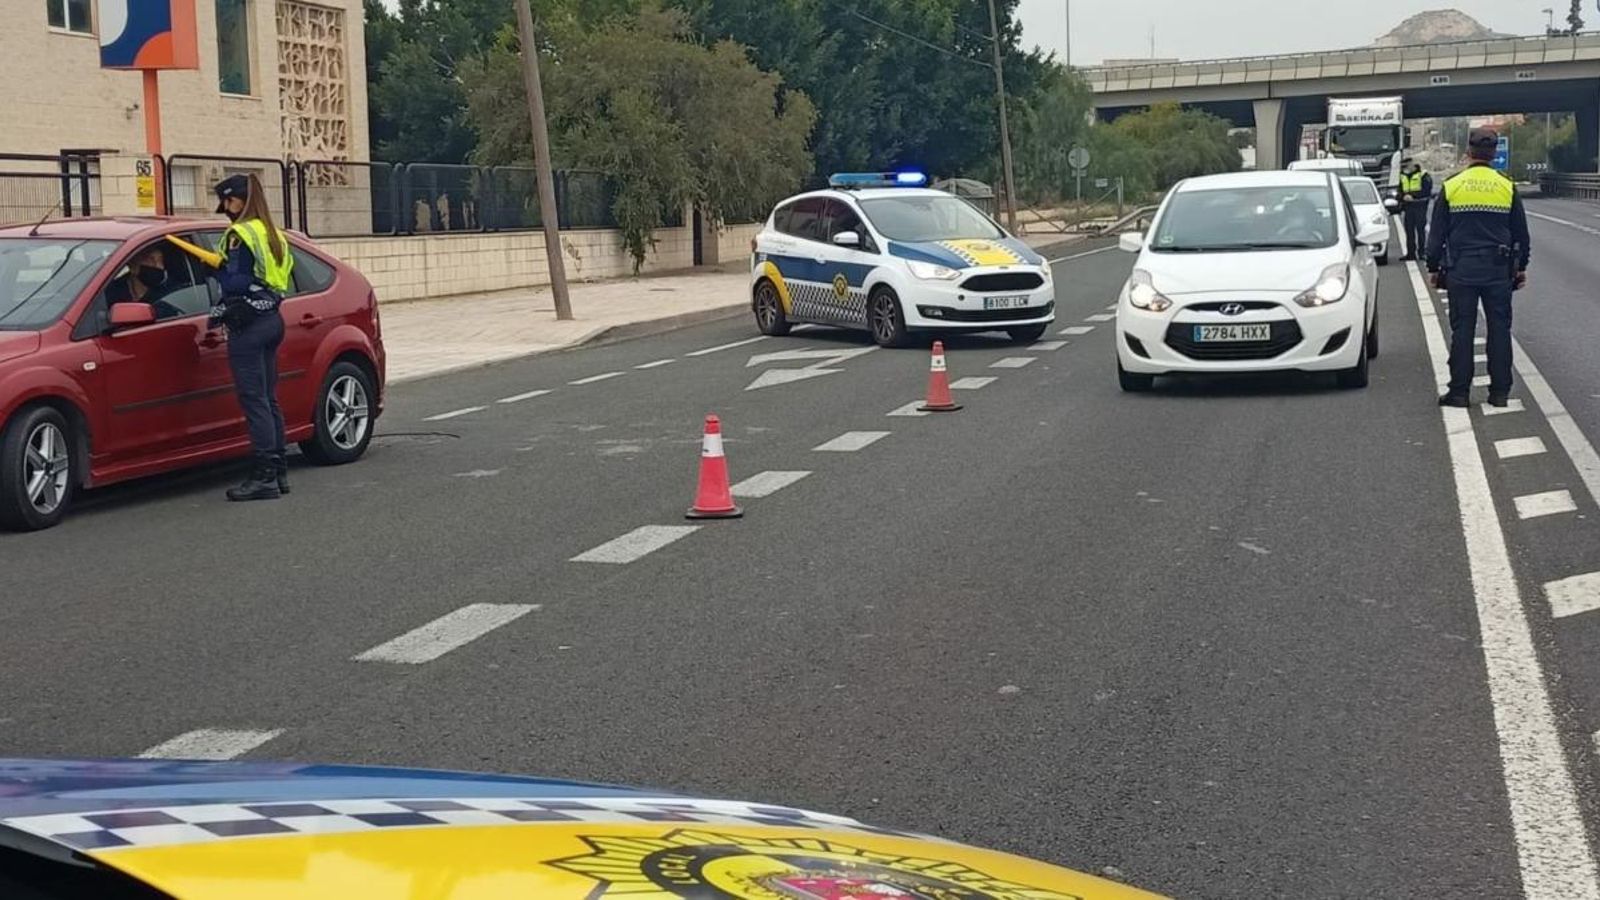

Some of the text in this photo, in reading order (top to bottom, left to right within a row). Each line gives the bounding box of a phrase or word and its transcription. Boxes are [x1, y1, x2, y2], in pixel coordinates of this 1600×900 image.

[136, 160, 151, 177] 65
[1203, 326, 1267, 339] 2784 HXX
